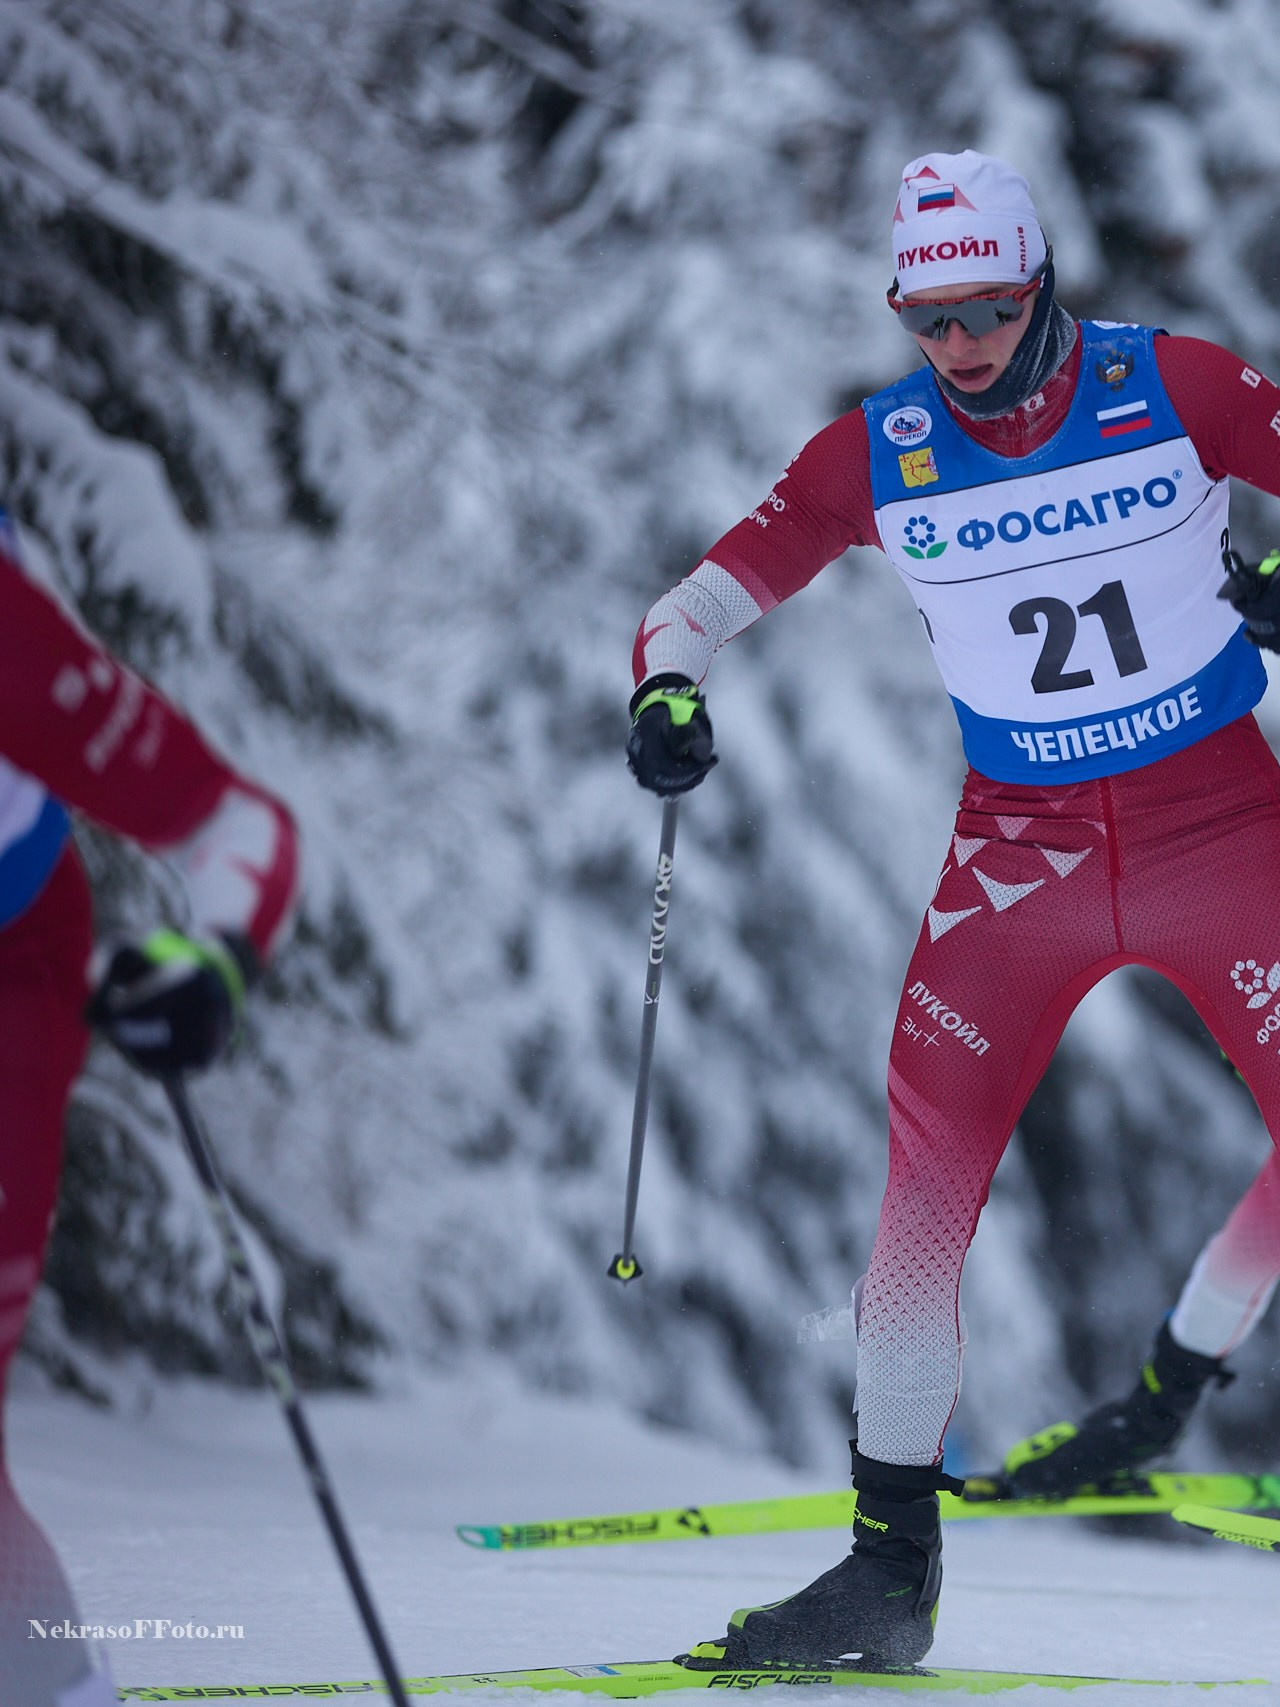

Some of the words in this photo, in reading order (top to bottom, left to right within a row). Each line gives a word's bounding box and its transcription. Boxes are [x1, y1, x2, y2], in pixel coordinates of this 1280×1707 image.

[898, 236, 999, 271] ЛУКОЙЛ
[1017, 226, 1027, 272] BIVIUM
[894, 430, 927, 443] ПЕРЕКОП
[1008, 579, 1148, 694] 21
[1010, 685, 1203, 763] ЧЕПЕЦКОЕ
[907, 980, 991, 1056] ЛУКОЙЛ
